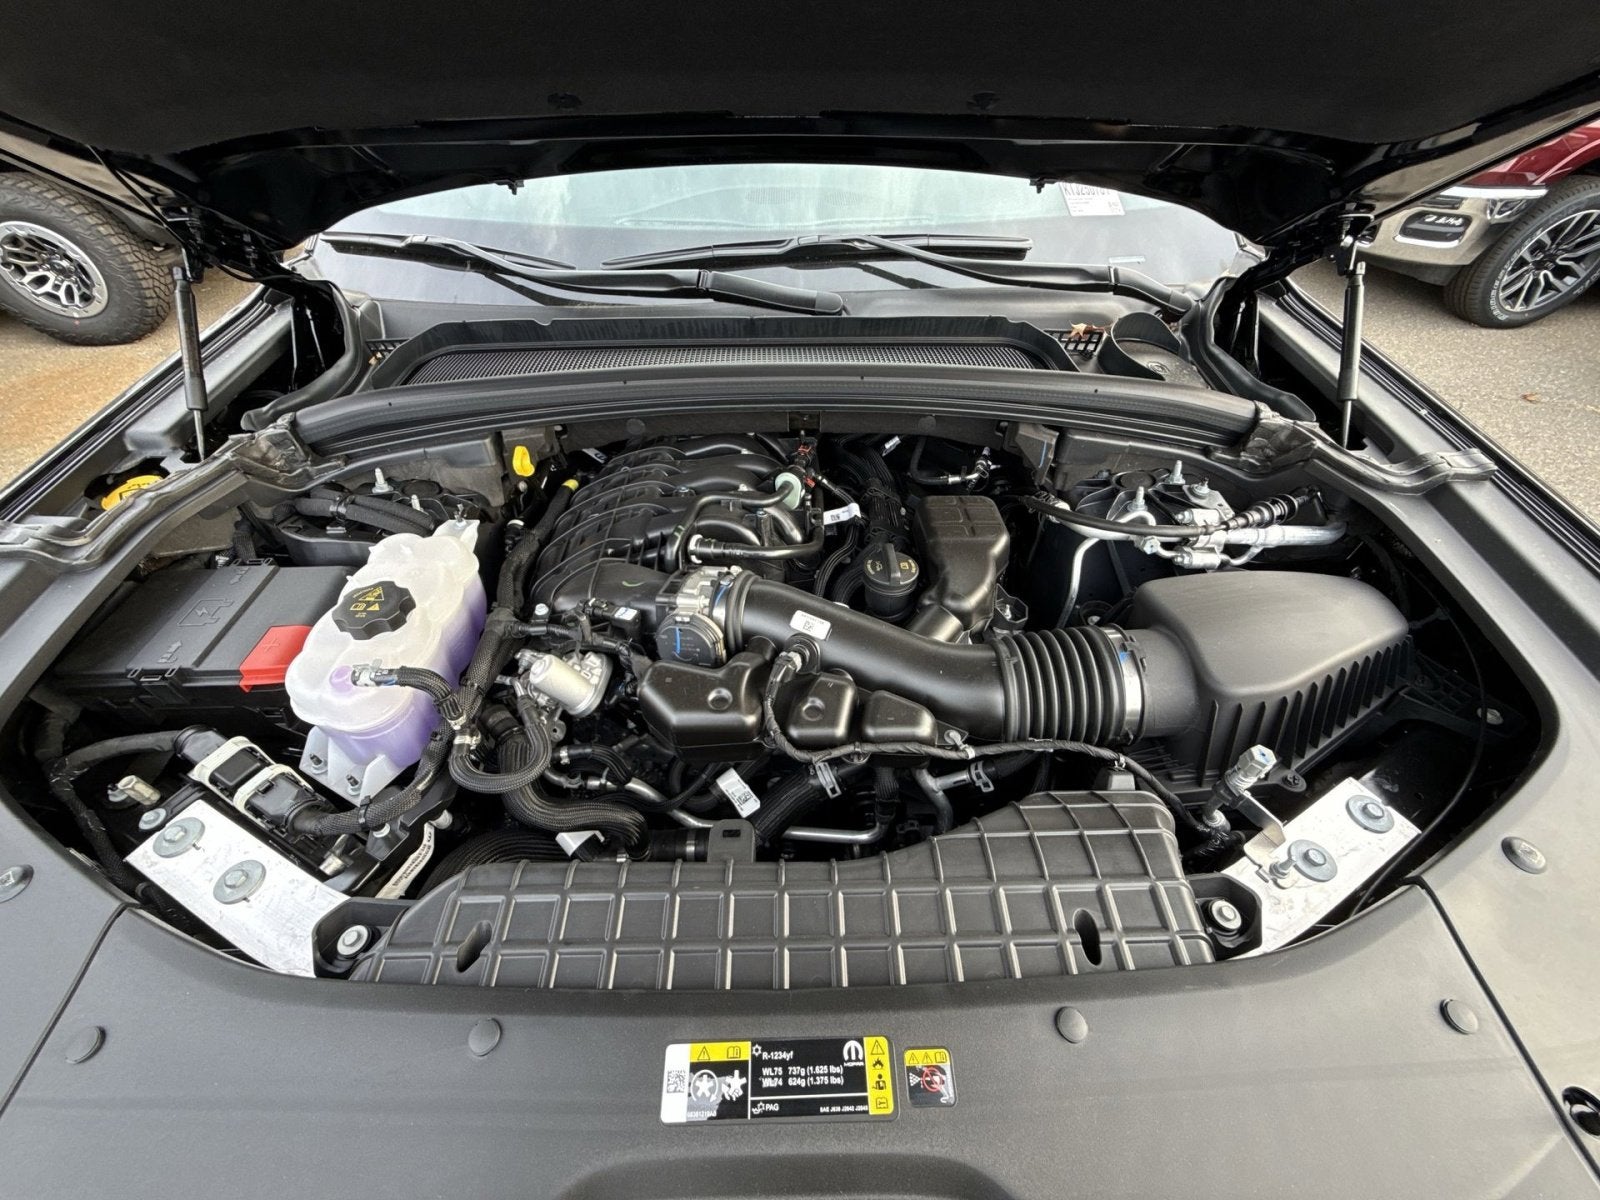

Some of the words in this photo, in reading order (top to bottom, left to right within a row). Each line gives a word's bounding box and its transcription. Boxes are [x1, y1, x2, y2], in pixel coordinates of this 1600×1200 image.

[762, 1050, 794, 1061] R-1234yf
[762, 1067, 783, 1076] WL75
[788, 1066, 806, 1077] 737g
[807, 1065, 828, 1076] (1.625
[829, 1064, 844, 1075] lbs)
[762, 1077, 783, 1088] WL74
[788, 1077, 806, 1087] 624g
[807, 1076, 829, 1087] (1.375
[830, 1075, 845, 1086] lbs)
[765, 1103, 779, 1112] PAG
